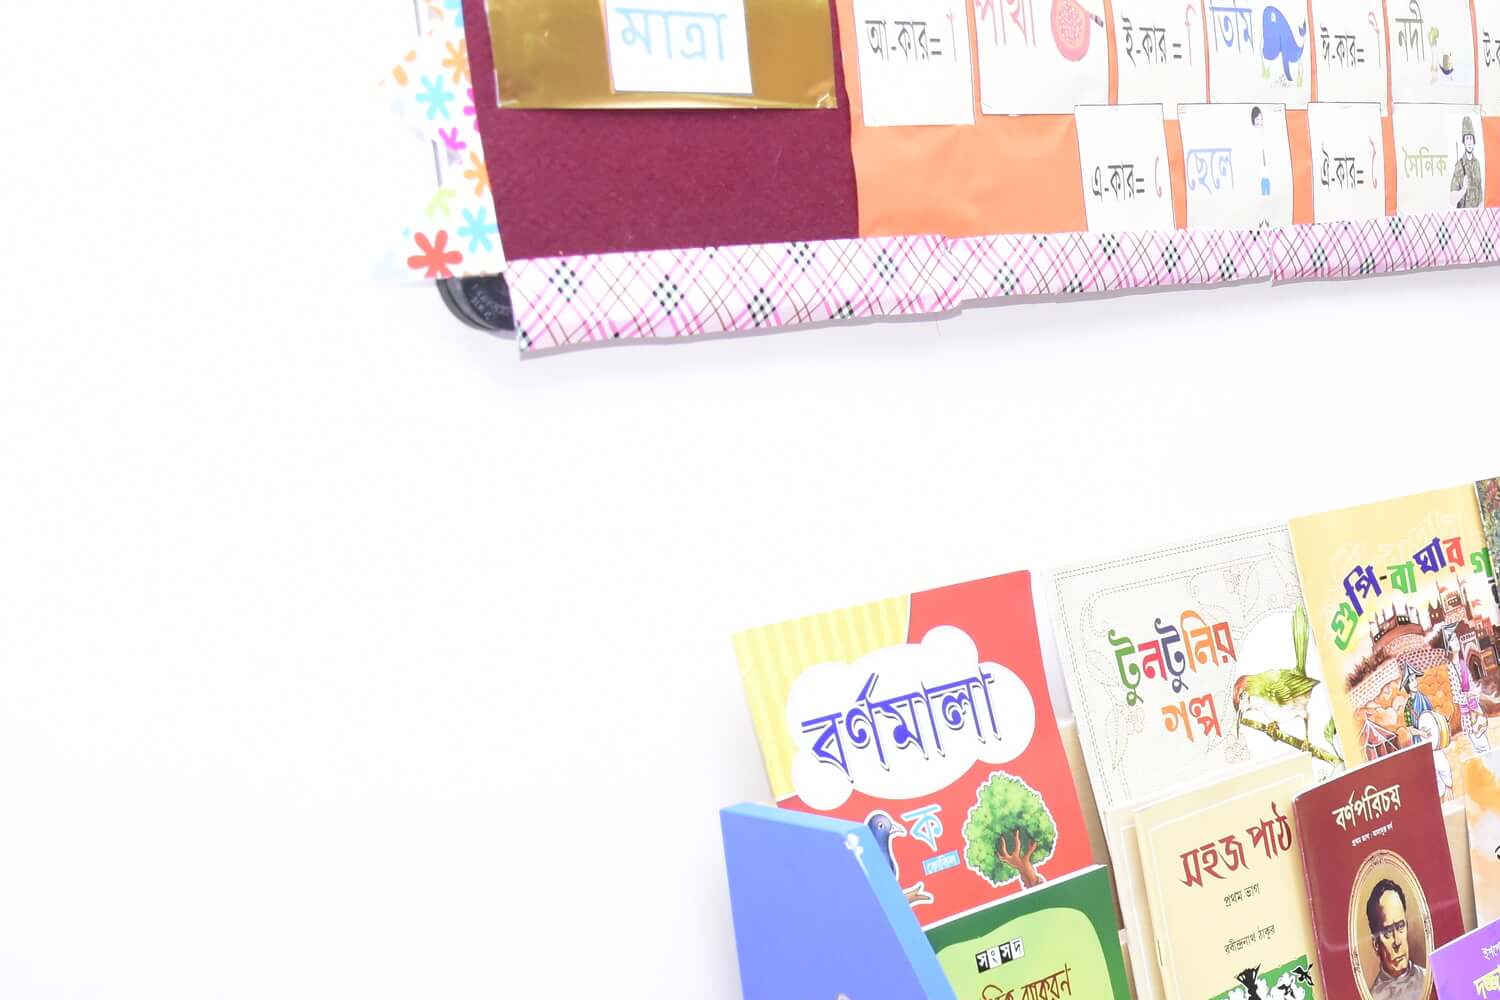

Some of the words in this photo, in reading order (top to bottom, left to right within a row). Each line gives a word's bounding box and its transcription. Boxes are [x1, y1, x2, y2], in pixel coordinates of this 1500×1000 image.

[615, 7, 728, 63] মাত্রা
[1395, 0, 1425, 62] নদী
[1187, 148, 1235, 194] ছেলে
[1401, 145, 1448, 179] সৈনিক
[1107, 609, 1237, 706] টুনটুনির
[801, 665, 1002, 784] বর্ণমালা
[1161, 693, 1222, 743] গল্প
[901, 804, 943, 852] ক
[1331, 784, 1401, 831] বর্ণপরিচয়
[1179, 834, 1250, 888] সহজ
[1245, 801, 1292, 860] পাঠ
[1224, 890, 1243, 908] প্রথম
[1244, 882, 1261, 898] ভাগ
[976, 939, 1024, 972] সংসদ
[1224, 933, 1257, 954] রবীন্দ্রনাথ
[1257, 924, 1276, 940] ঠাকুর
